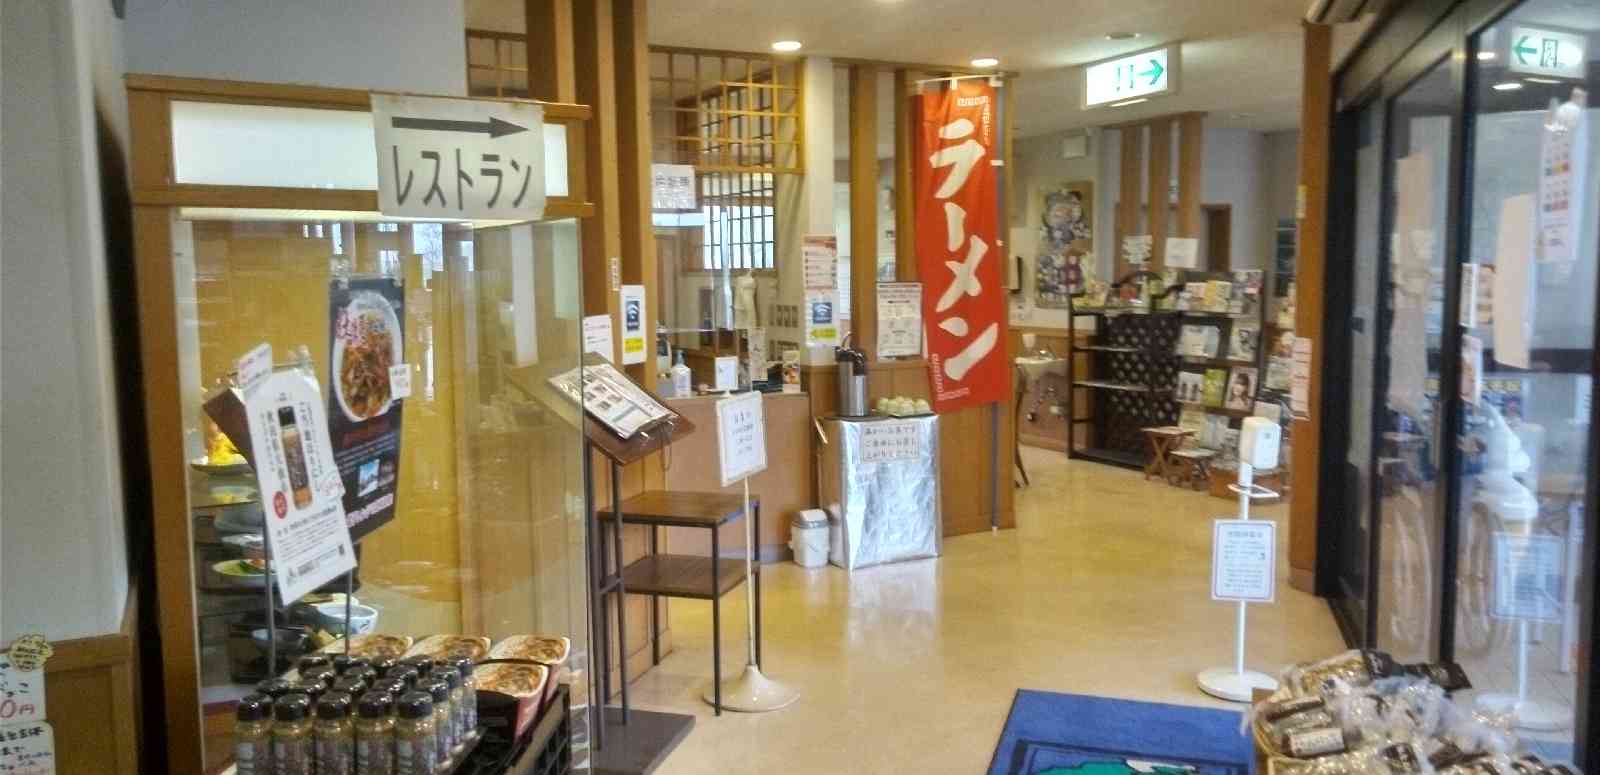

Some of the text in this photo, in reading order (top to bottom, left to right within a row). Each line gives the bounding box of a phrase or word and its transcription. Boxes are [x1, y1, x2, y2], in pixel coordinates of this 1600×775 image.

[393, 145, 531, 210] レストラン
[929, 118, 998, 381] ラーメン
